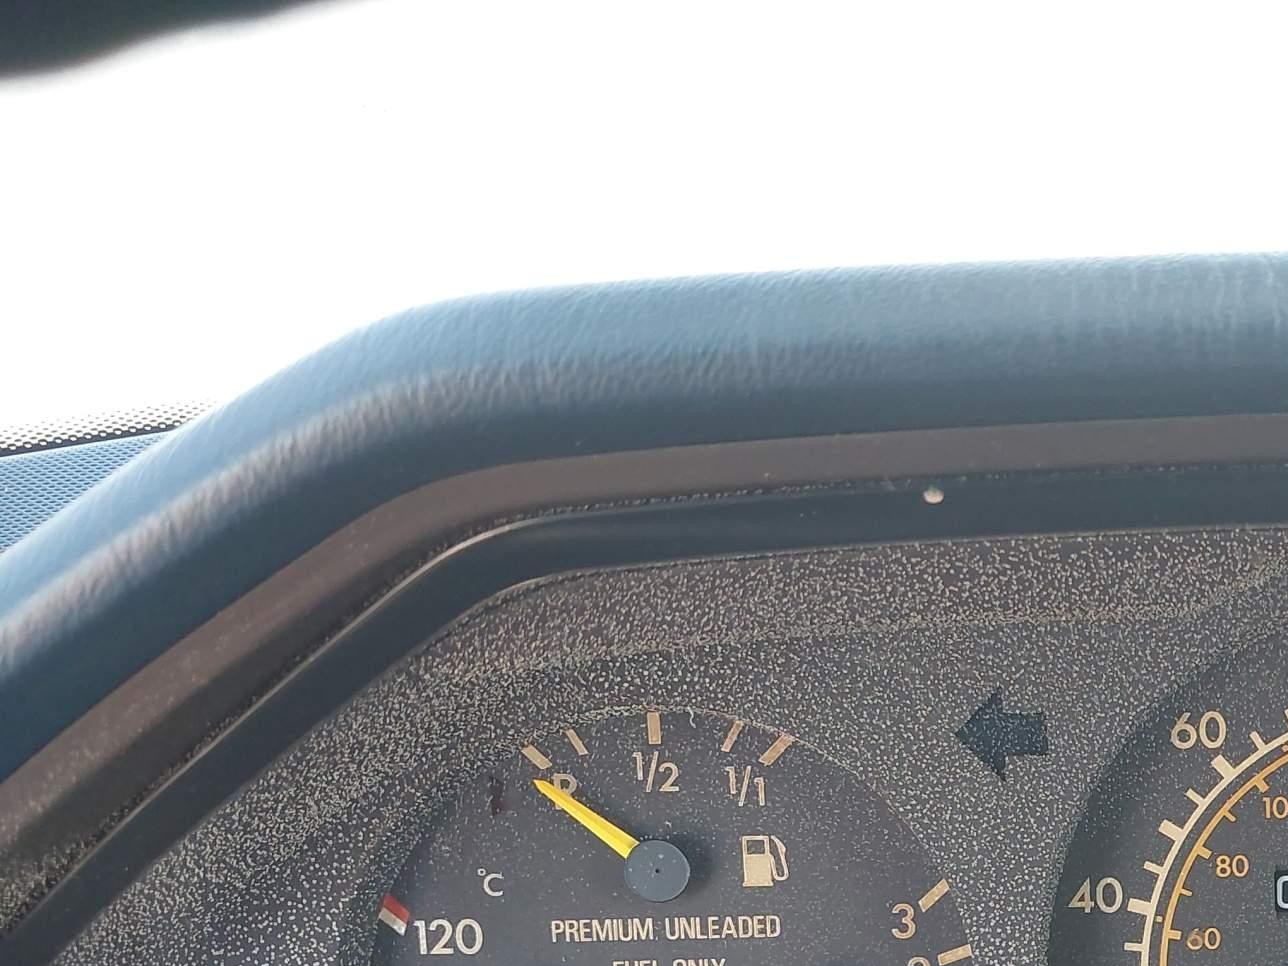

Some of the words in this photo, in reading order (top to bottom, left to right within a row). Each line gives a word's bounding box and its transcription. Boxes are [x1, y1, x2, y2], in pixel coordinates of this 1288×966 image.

[1170, 711, 1227, 749] 60
[632, 751, 680, 793] 1/2
[725, 765, 766, 807] 1/1
[1215, 854, 1250, 878] 80
[1067, 877, 1124, 914] 40
[412, 918, 484, 955] 120
[551, 919, 654, 943] PREMIUM
[665, 914, 782, 940] UNLEADED
[891, 902, 916, 939] 3
[1186, 927, 1221, 950] 60
